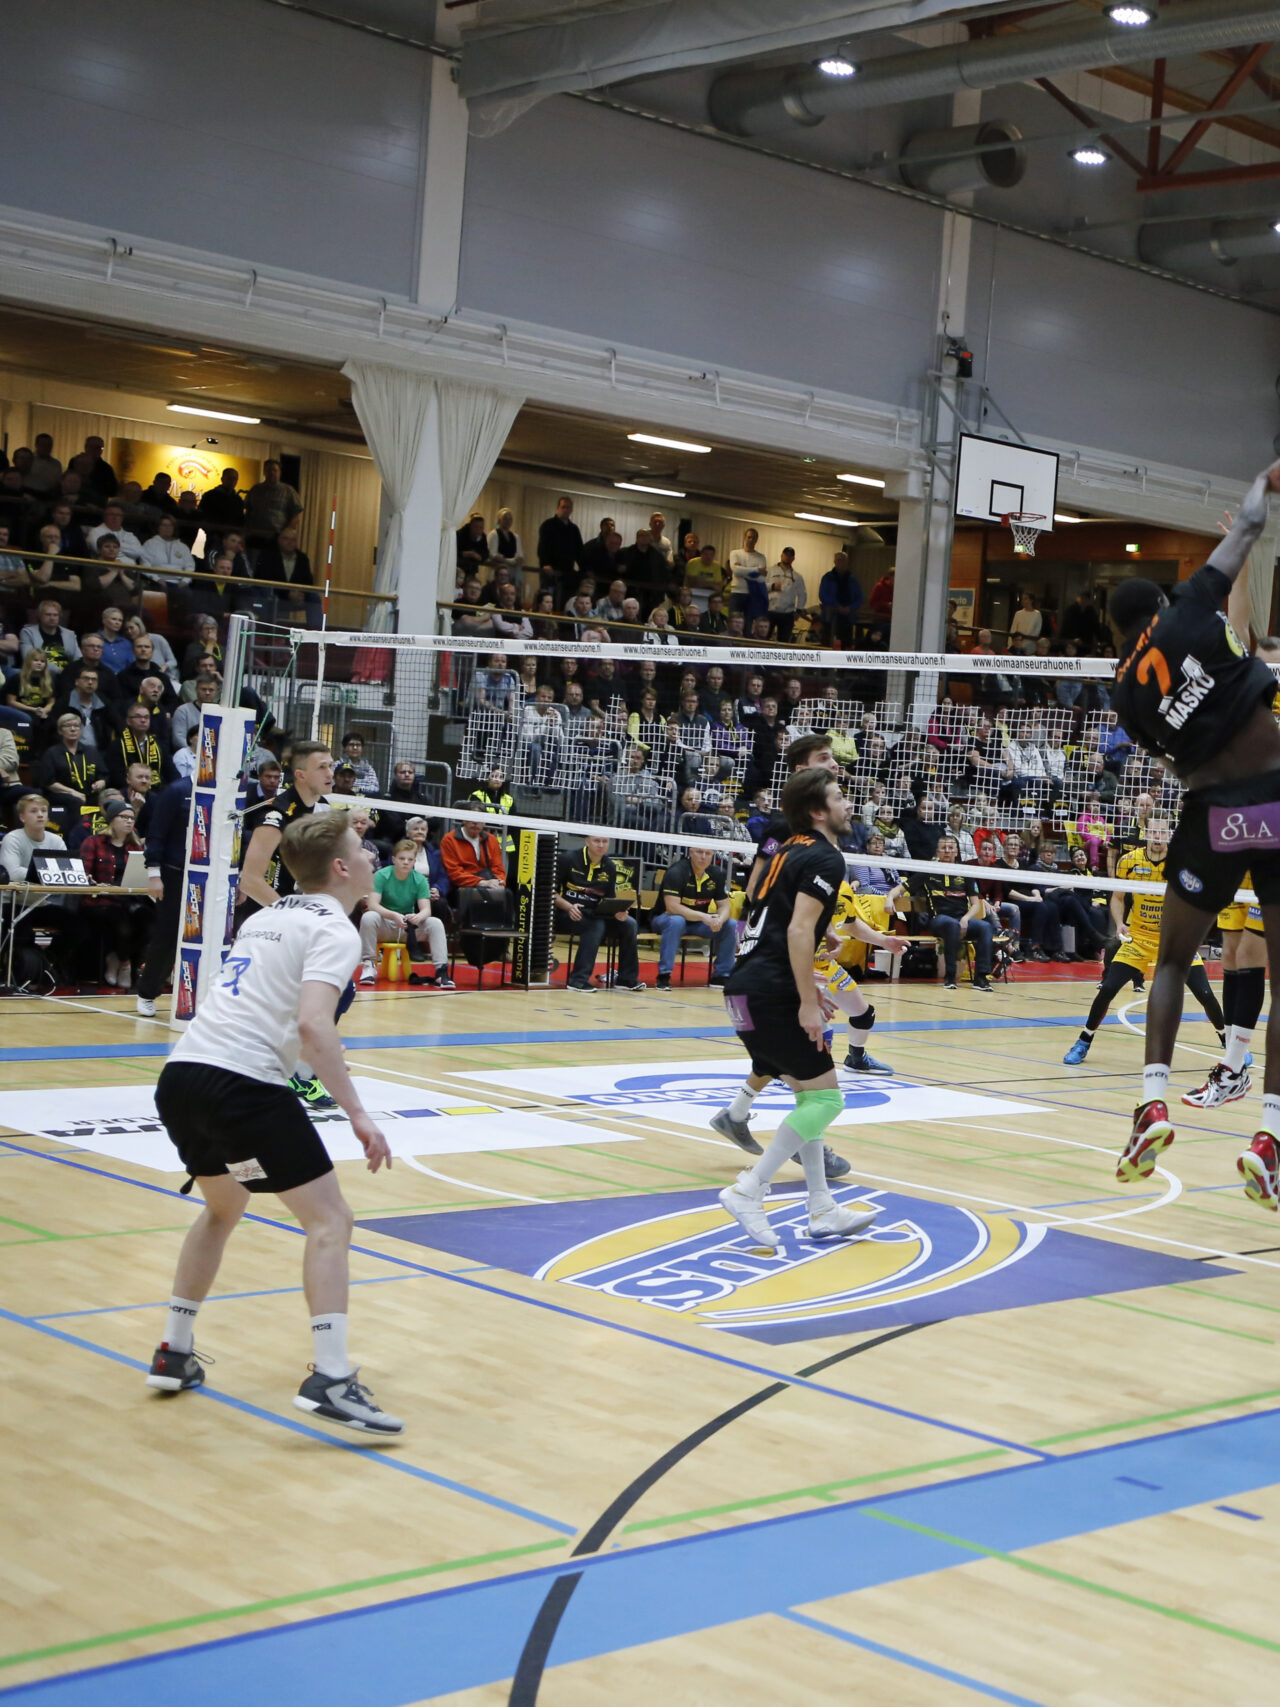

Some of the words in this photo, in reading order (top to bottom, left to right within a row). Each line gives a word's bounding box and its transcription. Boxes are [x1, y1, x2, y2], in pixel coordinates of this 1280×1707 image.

[622, 644, 708, 658] www.loimaanseurahuone.fi
[729, 648, 822, 663] www.loimaanseurahuone.fi
[845, 653, 946, 667] www.loimaanseurahuone.fi
[972, 657, 1082, 672] www.loimaanseurahuone.fi
[1164, 674, 1216, 731] MASKU
[42, 873, 62, 883] 02
[67, 873, 87, 884] 06
